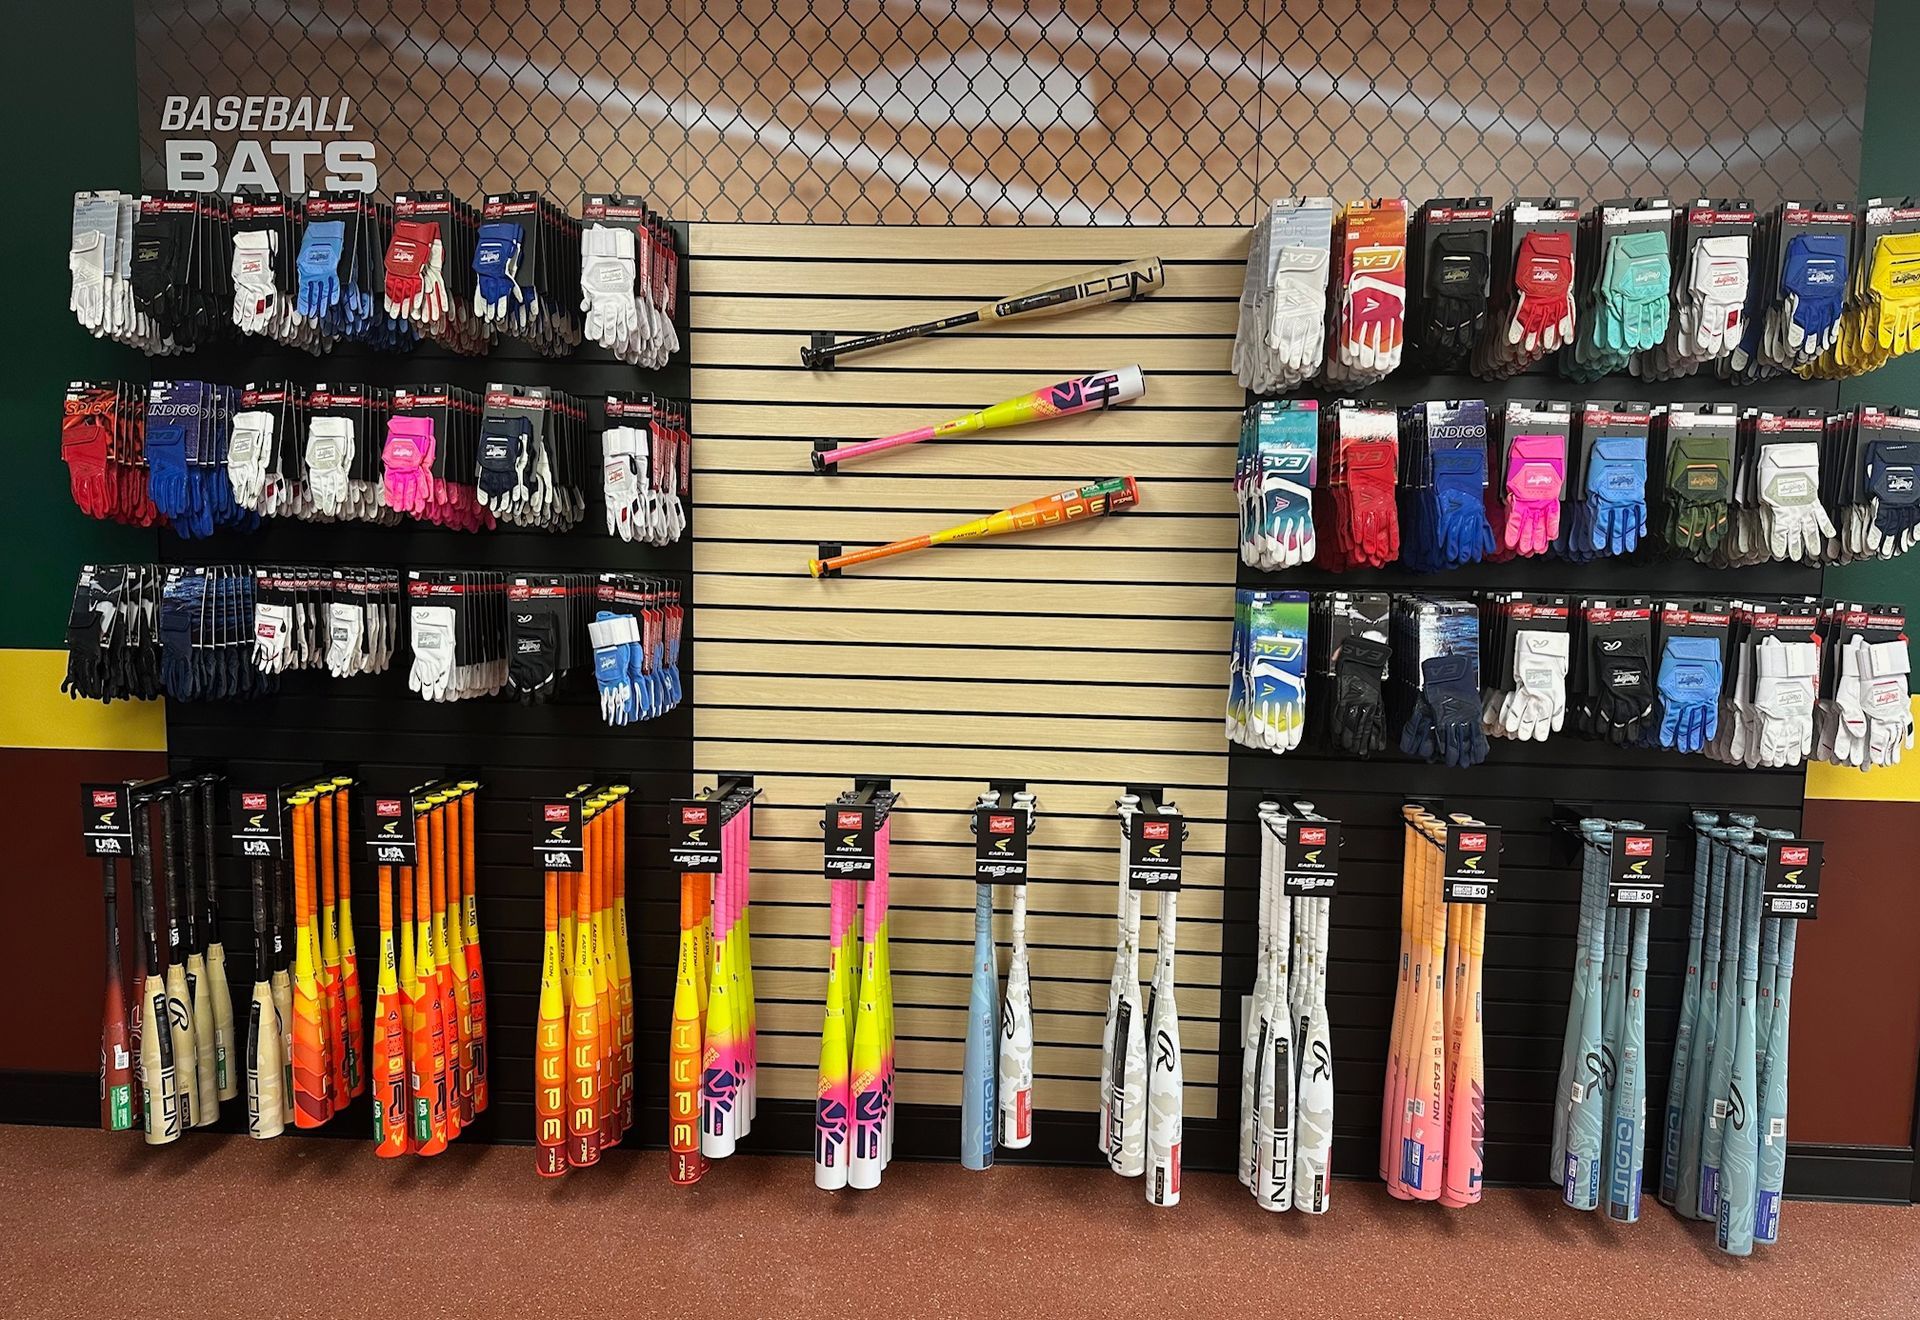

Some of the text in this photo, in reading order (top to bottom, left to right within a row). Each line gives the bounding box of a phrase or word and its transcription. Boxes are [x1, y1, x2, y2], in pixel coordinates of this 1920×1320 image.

[160, 95, 354, 131] BASEBALL
[165, 139, 378, 193] BATS
[1077, 266, 1155, 299] ICON
[65, 401, 115, 416] SPICY
[148, 404, 199, 416] INDIGO
[1430, 425, 1487, 439] INDIGO
[952, 531, 978, 539] EASTON
[161, 1066, 178, 1137] ICON
[1432, 1062, 1441, 1121] EASTON
[984, 1081, 993, 1150] CLOUT
[1270, 1130, 1289, 1203] ICON
[1614, 1122, 1633, 1204] CLOUT
